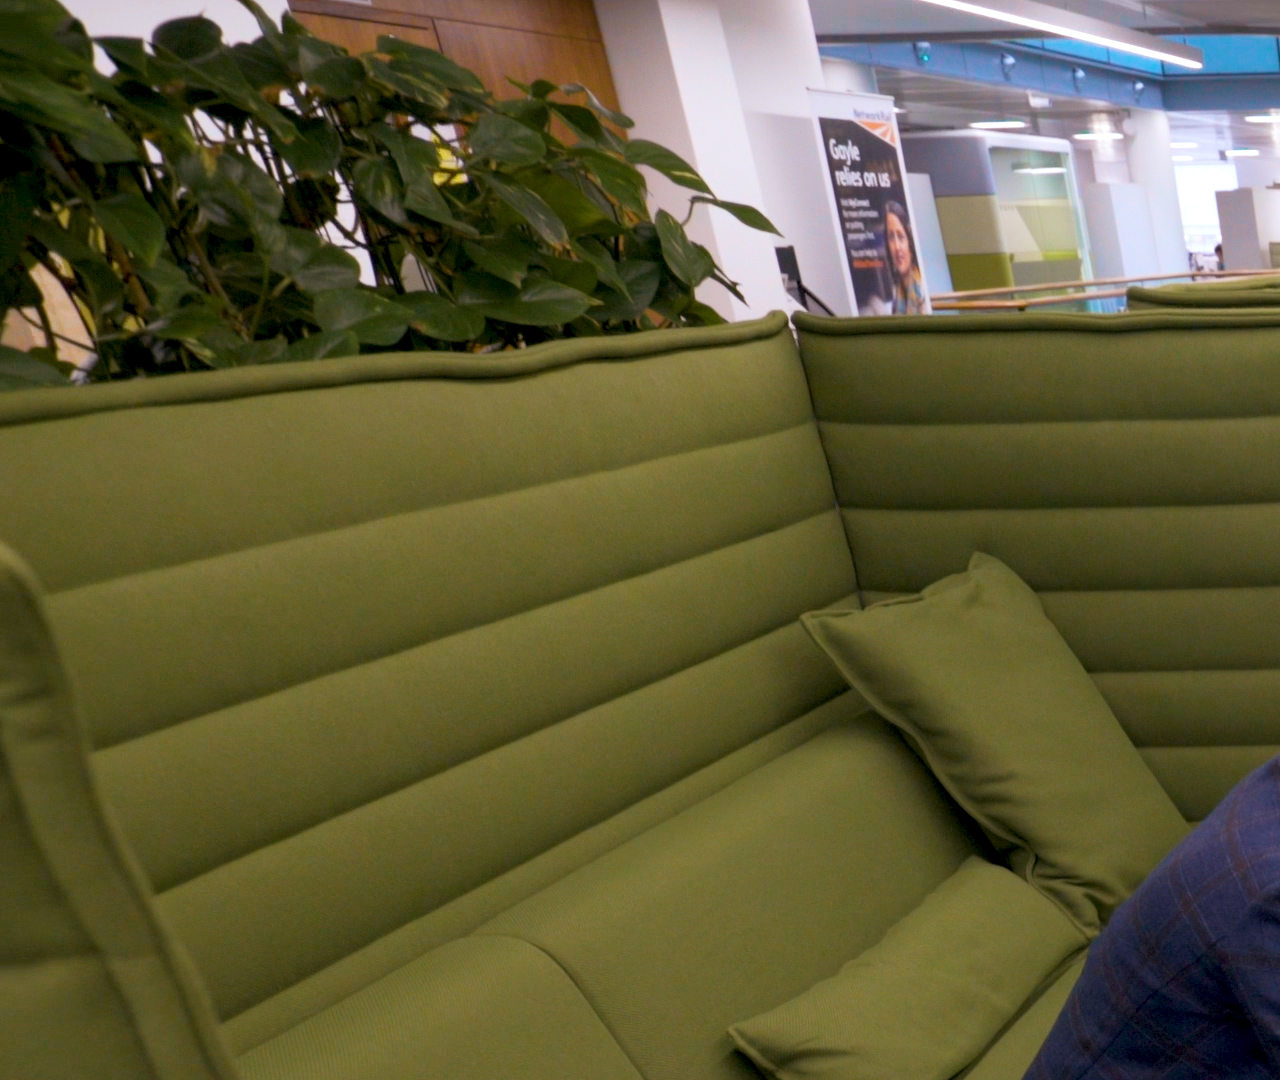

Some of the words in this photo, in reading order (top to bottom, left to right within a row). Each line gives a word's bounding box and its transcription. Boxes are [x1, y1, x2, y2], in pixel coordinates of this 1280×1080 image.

[829, 138, 860, 165] Gayle
[835, 166, 864, 188] relies
[864, 172, 878, 188] on
[878, 171, 891, 188] us
